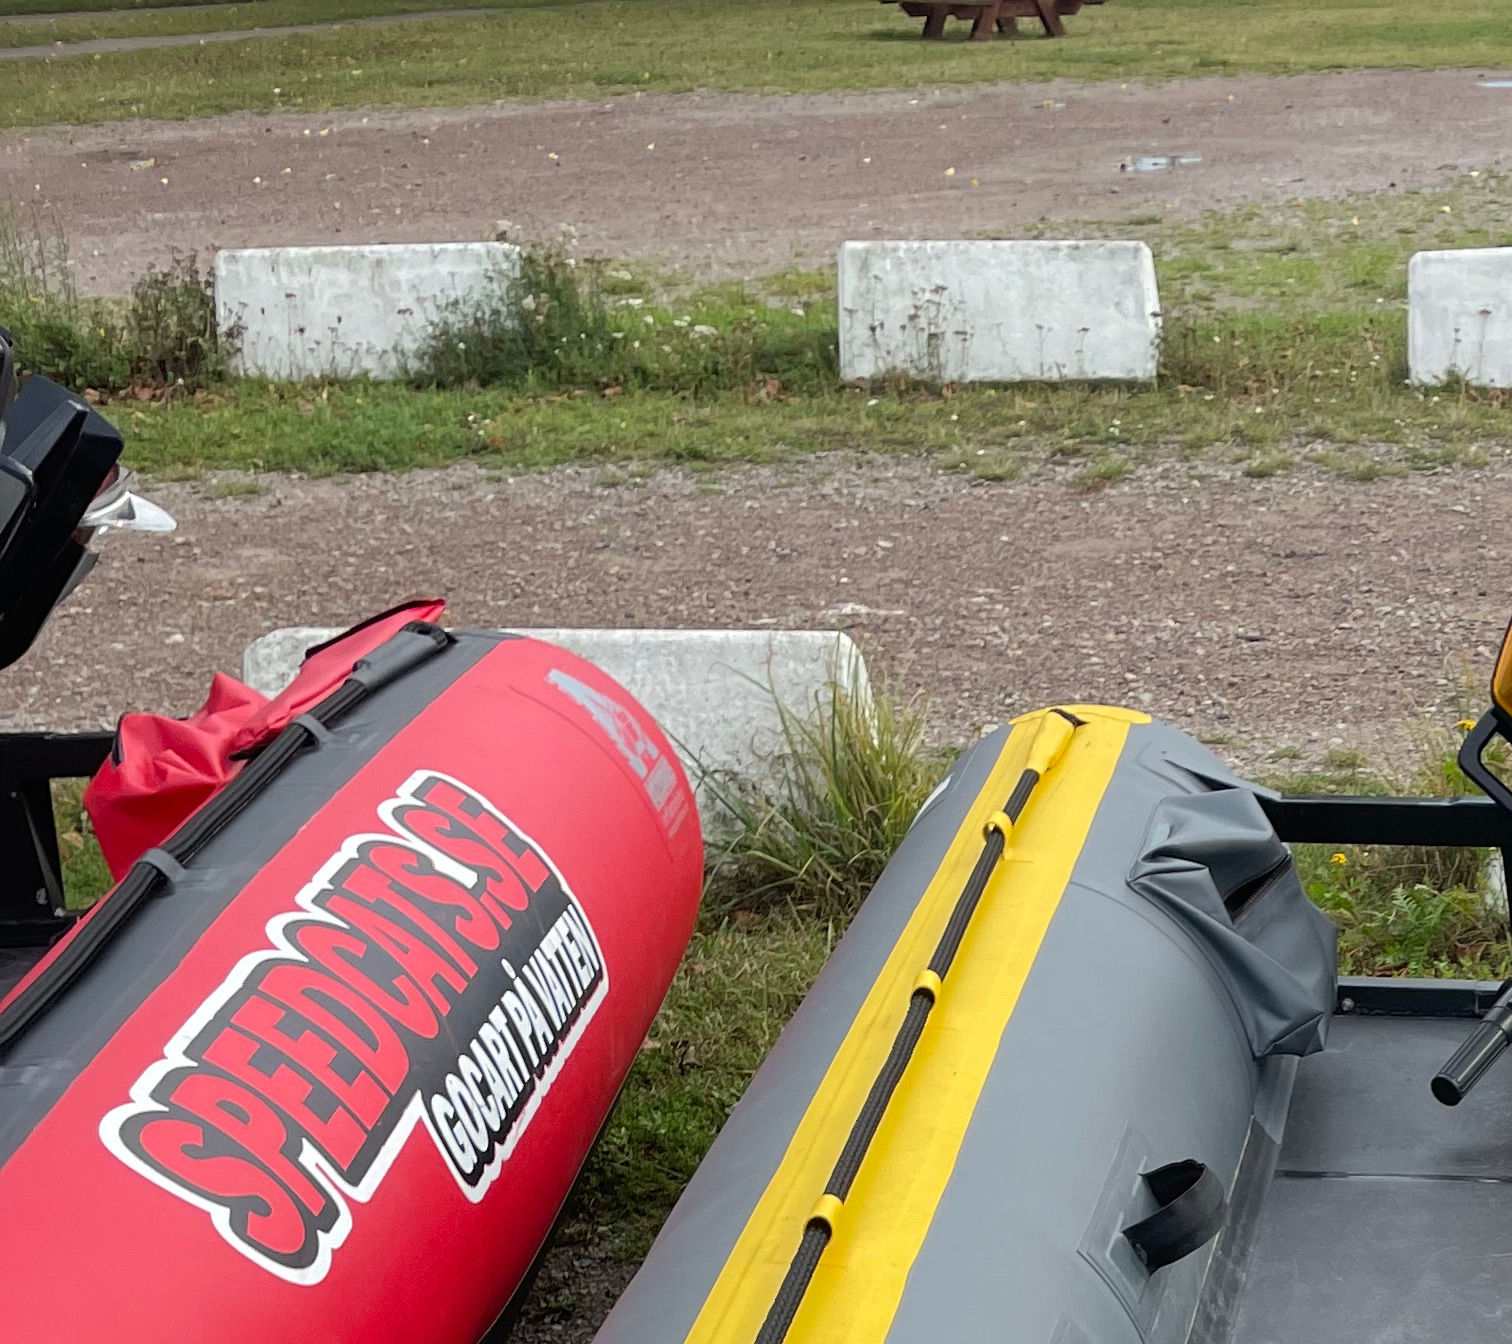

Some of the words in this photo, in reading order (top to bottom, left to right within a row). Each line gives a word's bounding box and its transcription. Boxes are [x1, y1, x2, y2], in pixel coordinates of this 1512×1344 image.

[138, 781, 551, 1254] SPEEDCATS.SE
[500, 958, 555, 1068] PÅ
[521, 903, 600, 1032] VATTEN
[431, 1005, 530, 1174] GOCART
